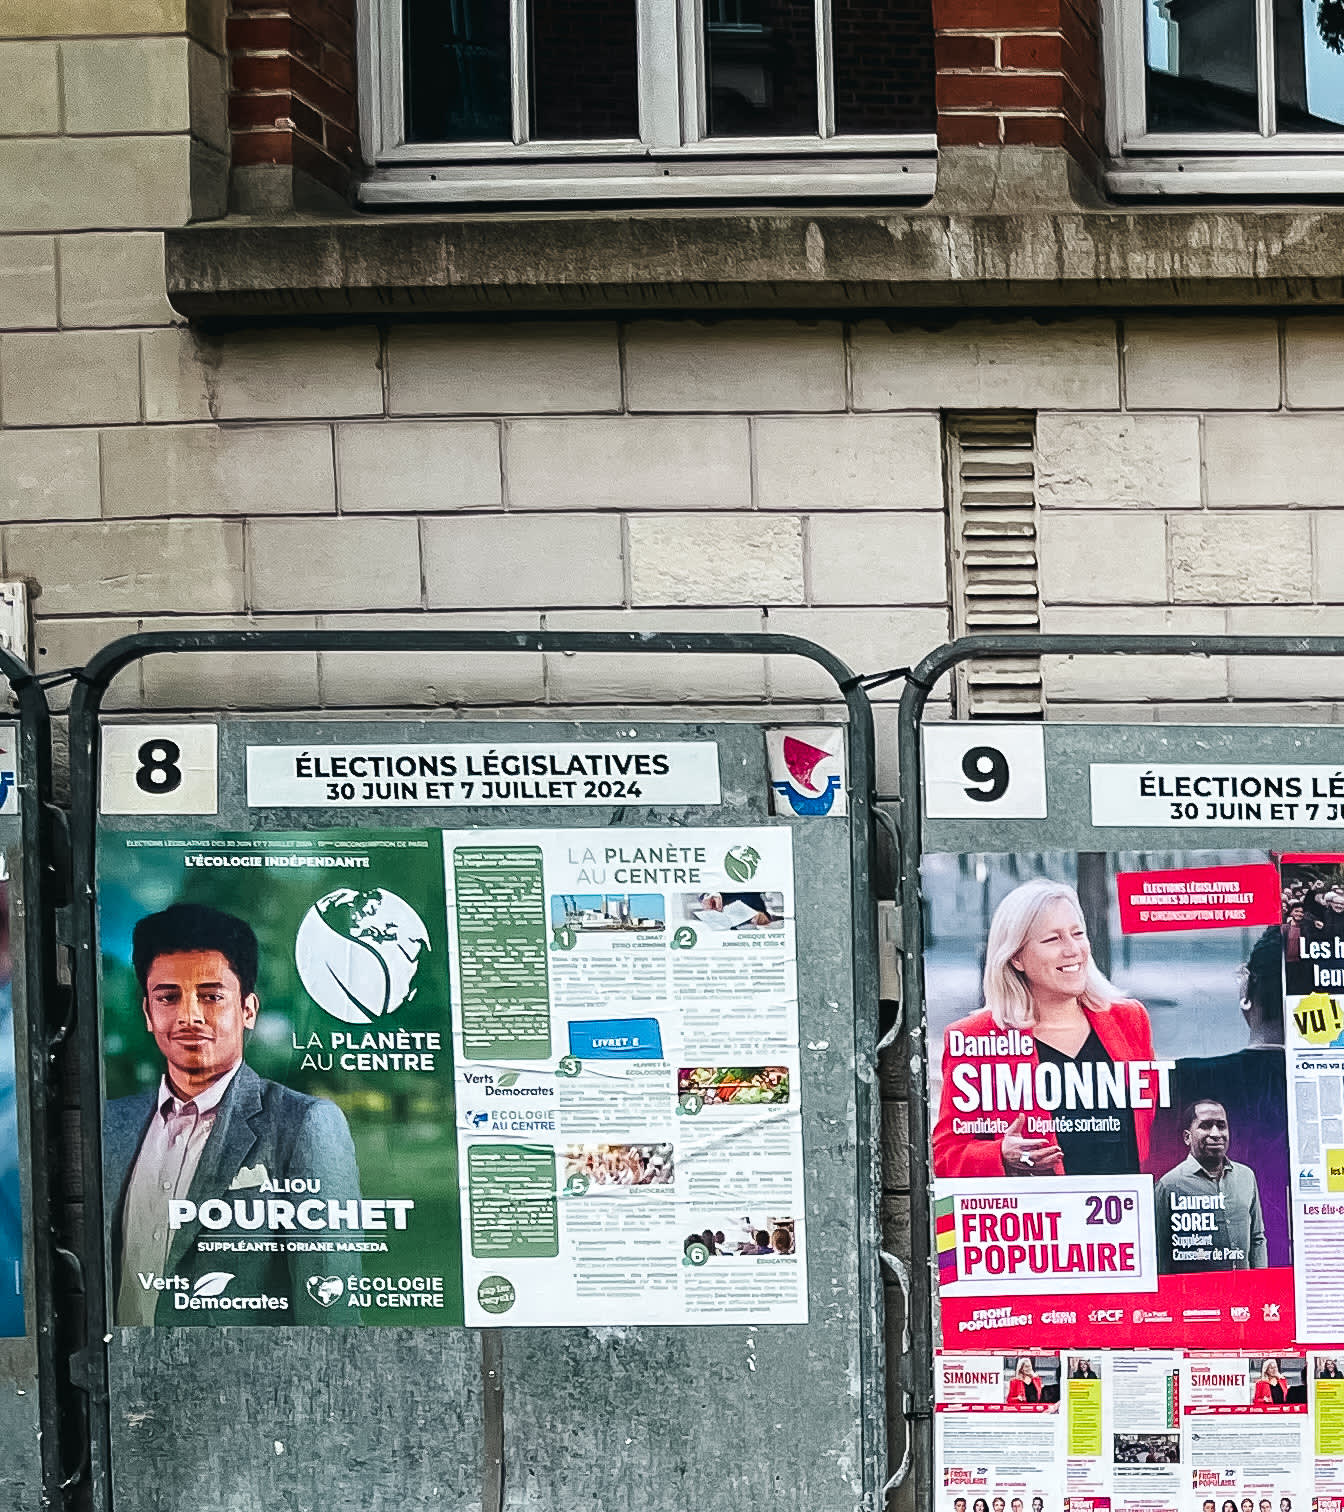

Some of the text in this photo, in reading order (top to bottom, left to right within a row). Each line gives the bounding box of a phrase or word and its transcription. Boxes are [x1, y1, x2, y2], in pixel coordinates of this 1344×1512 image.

[135, 738, 183, 794] 8
[295, 749, 670, 779] ÉLECTIONS LÉGISLATIVES
[961, 746, 1010, 802] 9
[326, 780, 642, 801] 30 JUIN ET 7 JUILLET 2024
[1139, 770, 1302, 798] ÉLECTIONS
[1170, 803, 1199, 820] 30
[1206, 804, 1263, 821] JUIN
[1270, 804, 1299, 821] ET
[1305, 804, 1319, 821] 7
[265, 855, 370, 868] INDÉPENDANTE
[568, 842, 707, 865] LA PLANÈTE
[577, 868, 701, 885] AU CENTRE
[1299, 936, 1331, 959] Les
[293, 1029, 441, 1049] LA PLANÈTE
[949, 1029, 1035, 1056] Danielle
[301, 1053, 435, 1071] AU CENTRE
[952, 1061, 1177, 1113] SIMONNET
[511, 1121, 556, 1130] CENTRE
[953, 1116, 1121, 1134] Candidate Députée sortante
[259, 1178, 321, 1193] ALIOU
[961, 1197, 1019, 1211] NOUVEAU
[1170, 1192, 1226, 1211] Laurent
[1303, 1203, 1320, 1215] Les
[168, 1199, 415, 1230] POURCHET
[1170, 1212, 1219, 1232] SOREL
[961, 1211, 1062, 1243] FRONT
[964, 1242, 1136, 1275] POPULAIRE
[139, 1272, 190, 1290] Verts
[347, 1274, 444, 1291] ÉCOLOGIE
[347, 1294, 444, 1308] AU CENTRE
[943, 1372, 1000, 1385] SIMONNET
[1190, 1374, 1246, 1387] SIMONNET
